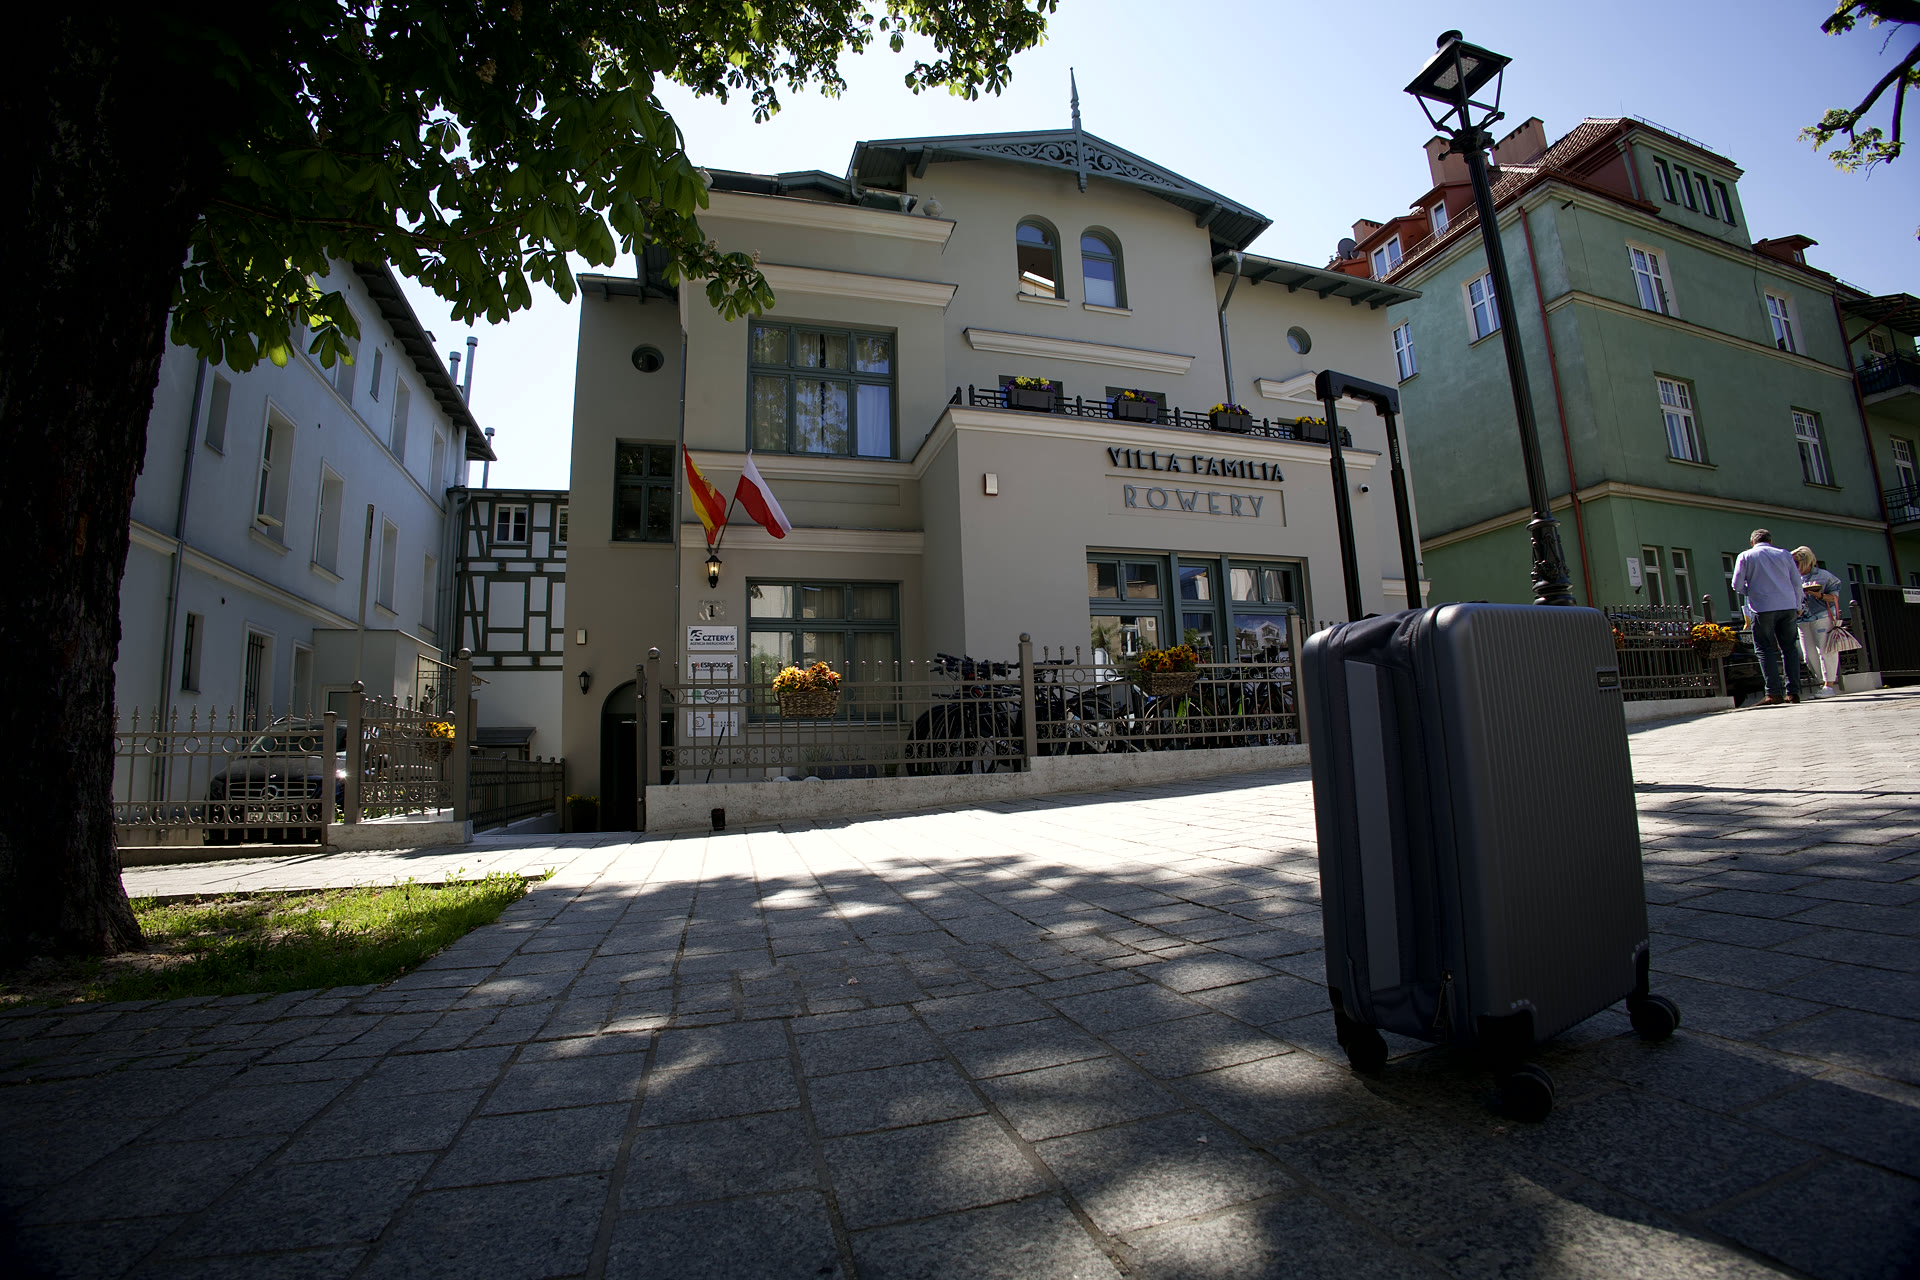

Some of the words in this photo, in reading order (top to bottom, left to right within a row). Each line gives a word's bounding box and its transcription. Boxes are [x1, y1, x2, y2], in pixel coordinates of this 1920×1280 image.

[1107, 446, 1181, 473] VILLA
[1192, 454, 1285, 482] FAMILIA
[1123, 483, 1264, 517] ROWERY
[709, 604, 715, 617] 1
